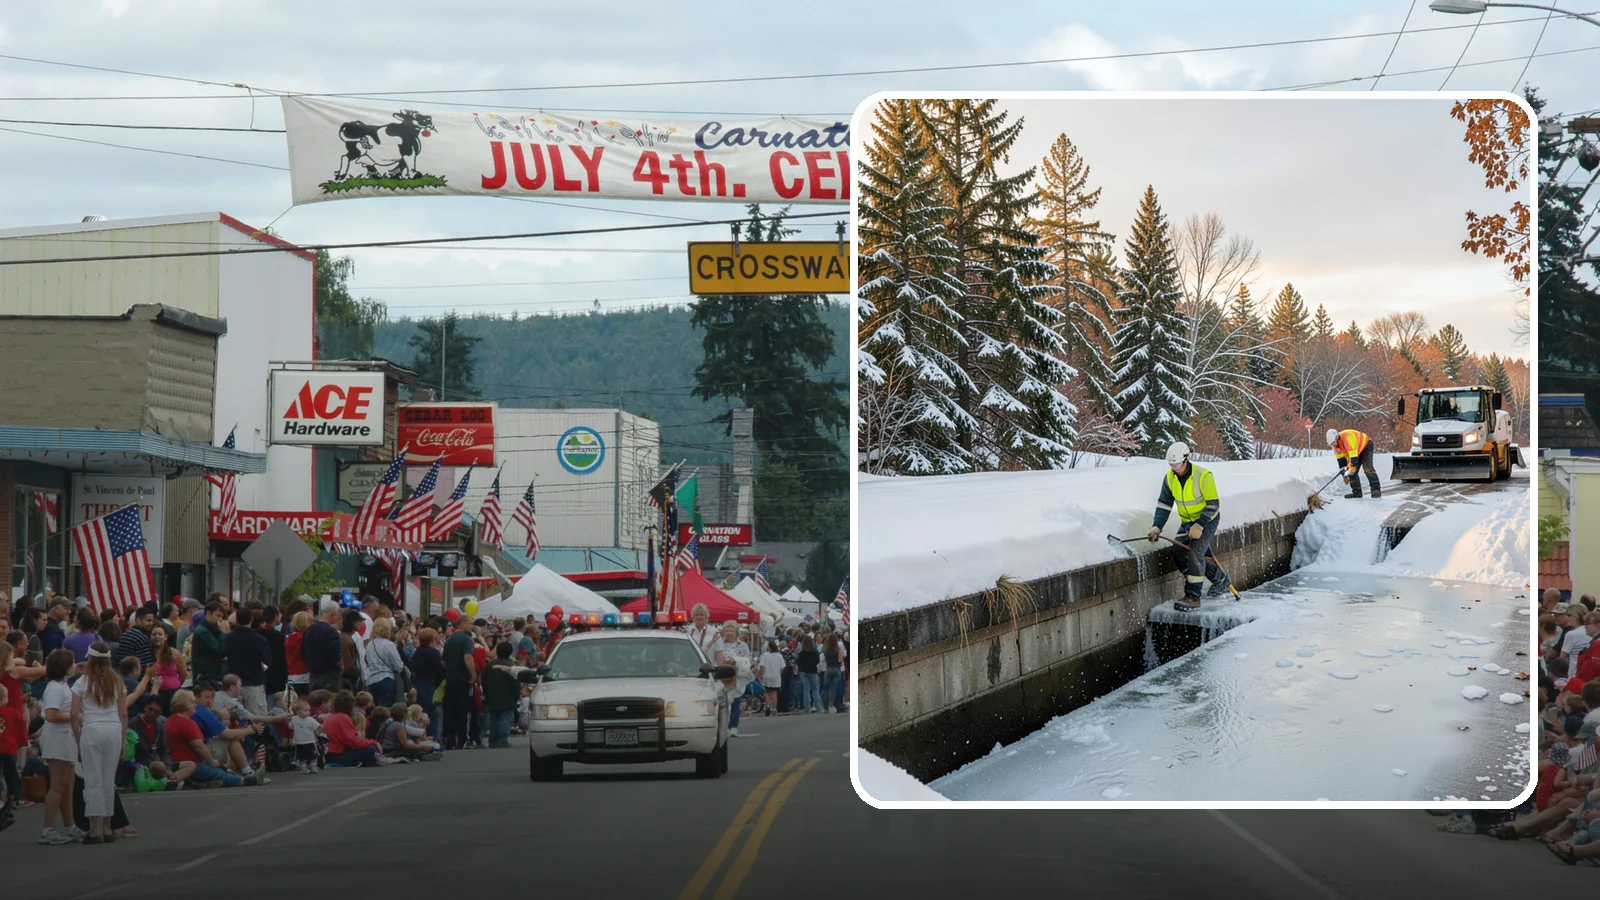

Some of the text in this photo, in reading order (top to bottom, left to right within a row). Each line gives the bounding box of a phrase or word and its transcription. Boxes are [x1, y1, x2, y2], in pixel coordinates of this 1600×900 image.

[481, 141, 605, 192] JULY
[632, 149, 746, 198] 4th.
[697, 254, 850, 280] CROSSWA
[283, 380, 373, 420] ACE
[406, 409, 485, 422] CEDAR LOG
[283, 421, 371, 436] Hardware
[416, 428, 477, 447] Coca-Cola
[353, 467, 386, 480] Simpl
[95, 485, 124, 494] Vincent
[126, 486, 135, 494] de
[137, 486, 155, 495] Paul
[213, 516, 331, 535] HARDARE
[688, 526, 741, 535] CRNATION
[699, 535, 730, 543] GLASS
